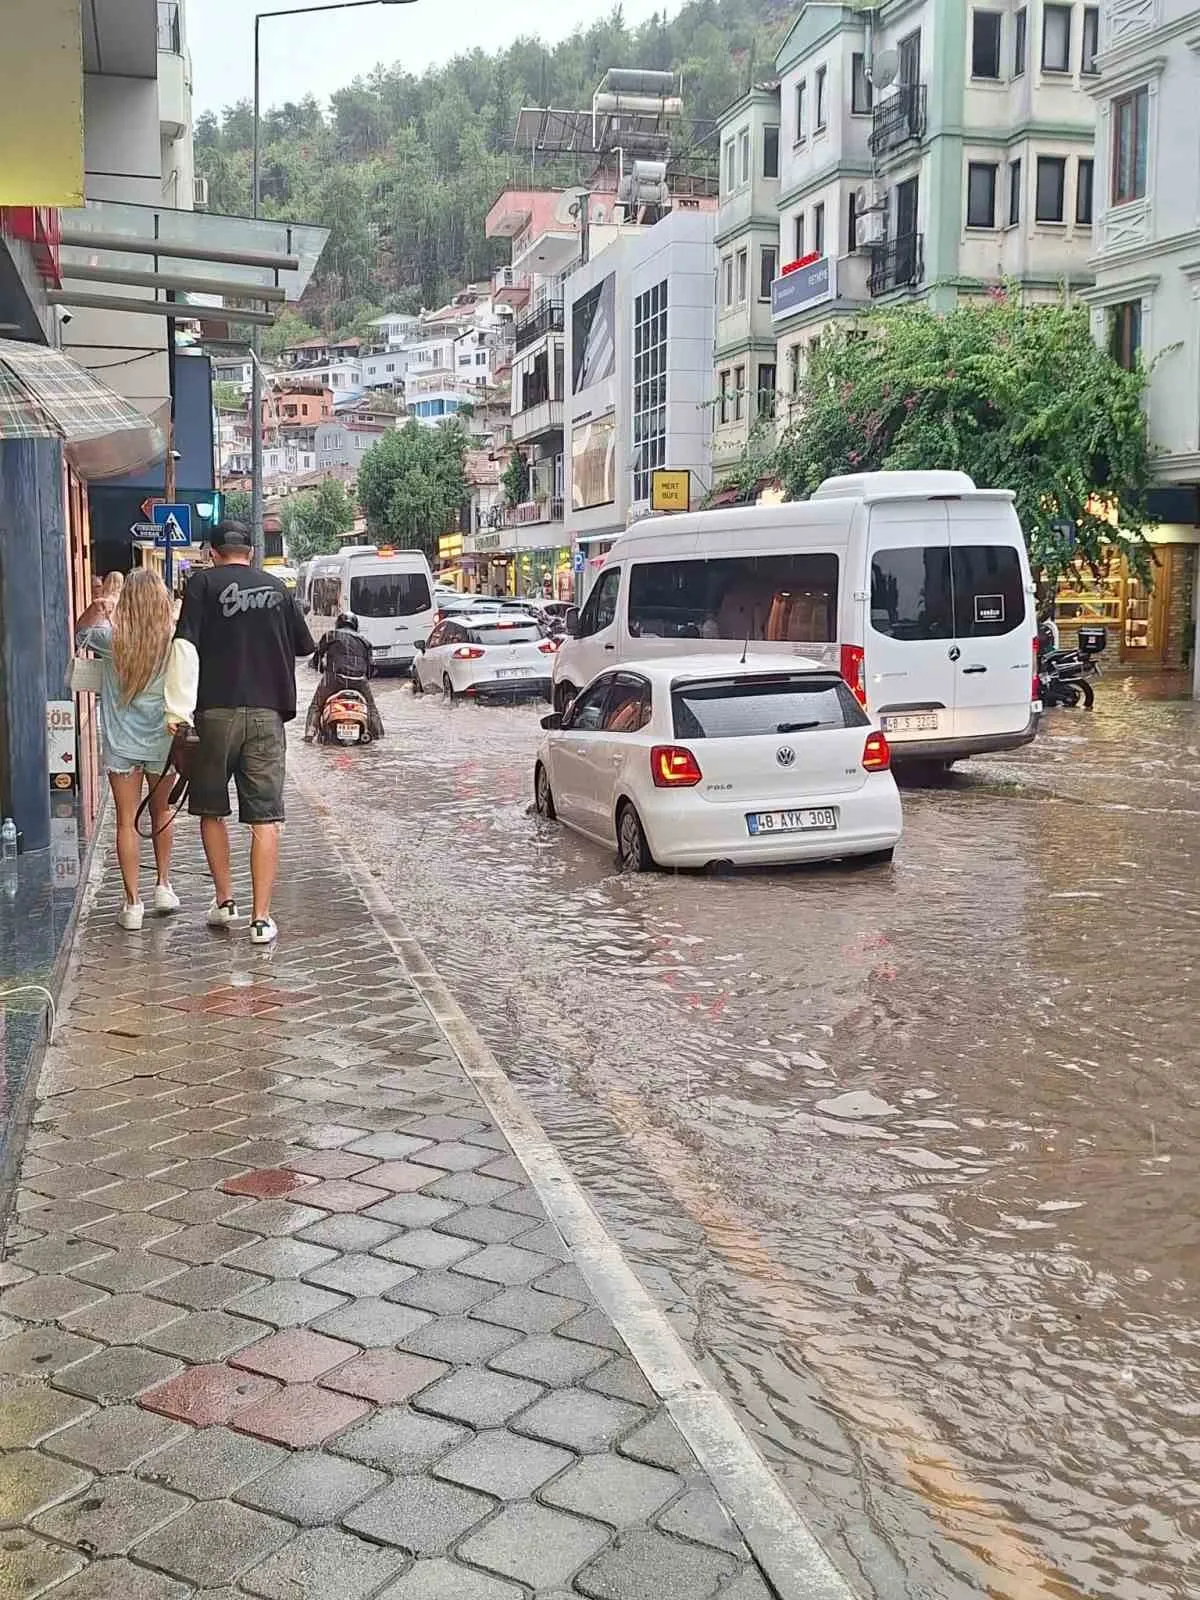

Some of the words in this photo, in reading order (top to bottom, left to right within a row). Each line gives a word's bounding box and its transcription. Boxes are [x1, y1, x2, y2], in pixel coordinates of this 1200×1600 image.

[758, 815, 774, 829] 48
[781, 812, 804, 828] AYK
[809, 810, 832, 825] 308
